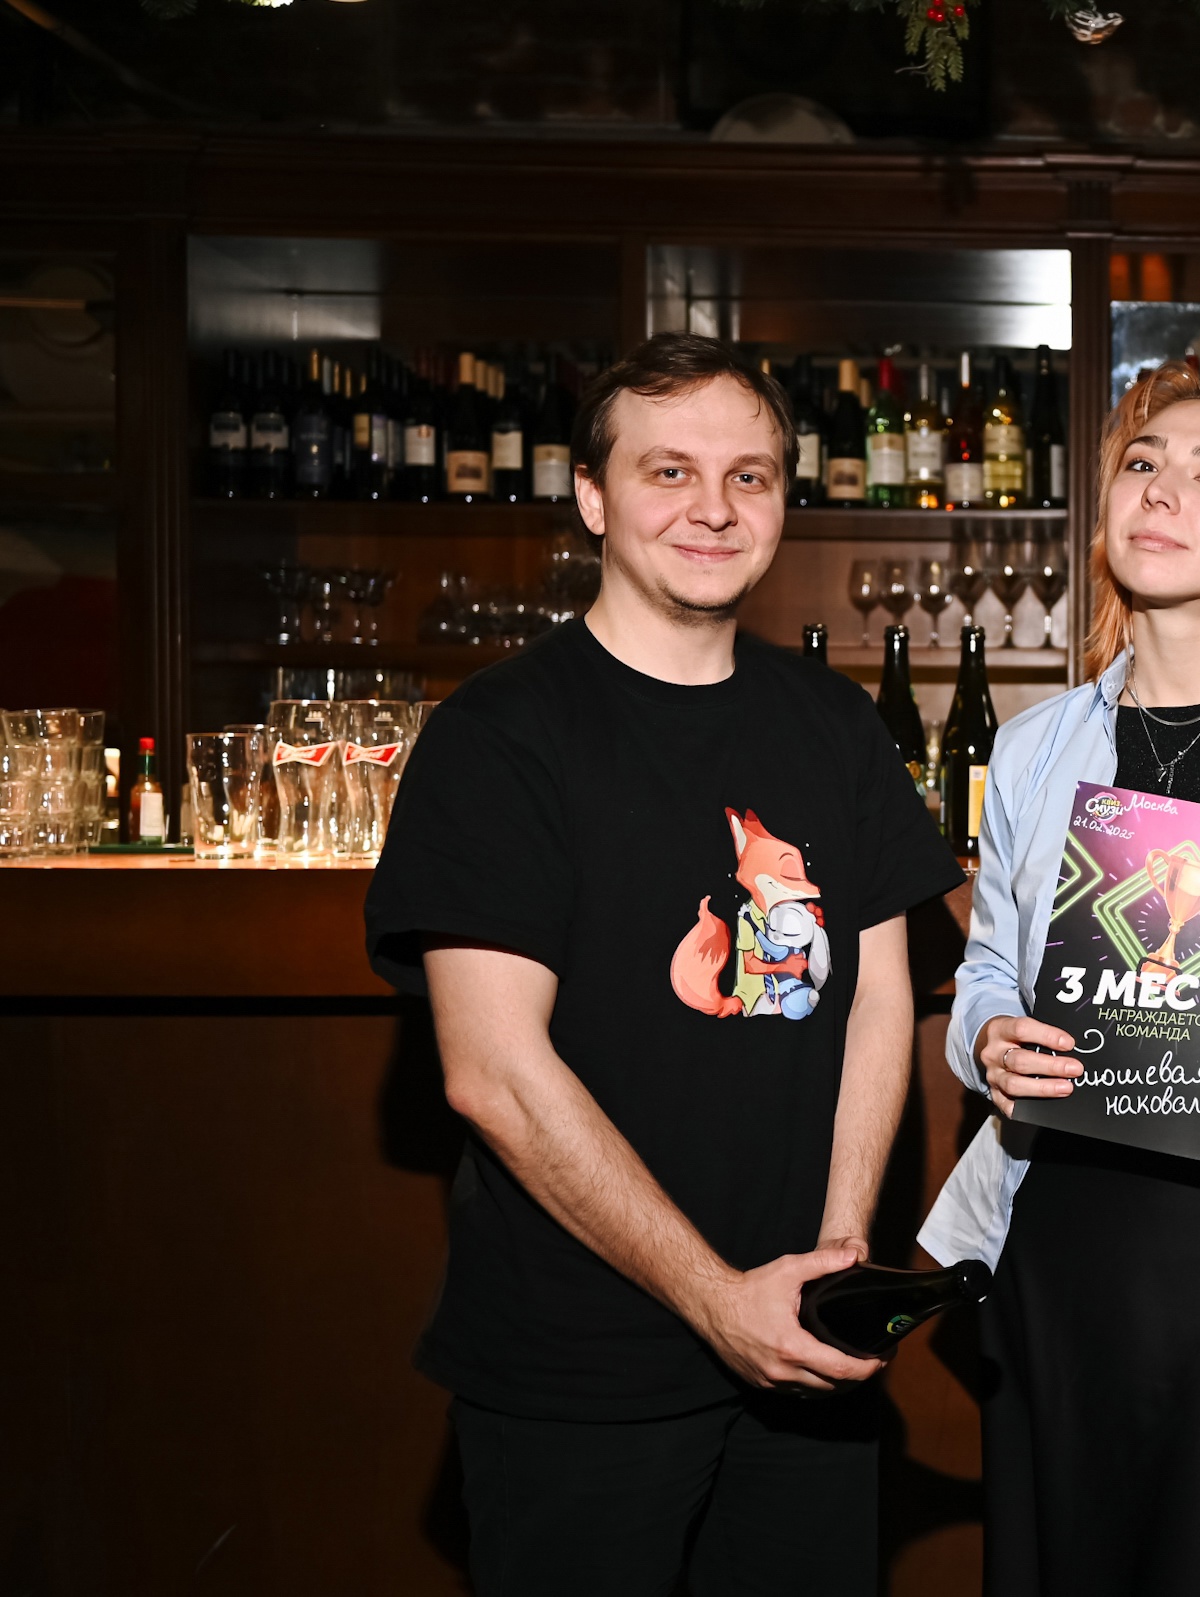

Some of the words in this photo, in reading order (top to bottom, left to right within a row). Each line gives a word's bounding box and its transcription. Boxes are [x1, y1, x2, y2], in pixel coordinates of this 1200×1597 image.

[1085, 798, 1124, 816] Смузи
[1124, 794, 1179, 815] Москва
[1073, 816, 1135, 840] 21.02.2025
[1055, 966, 1087, 1004] 3
[1115, 1023, 1191, 1042] КОМАНДА
